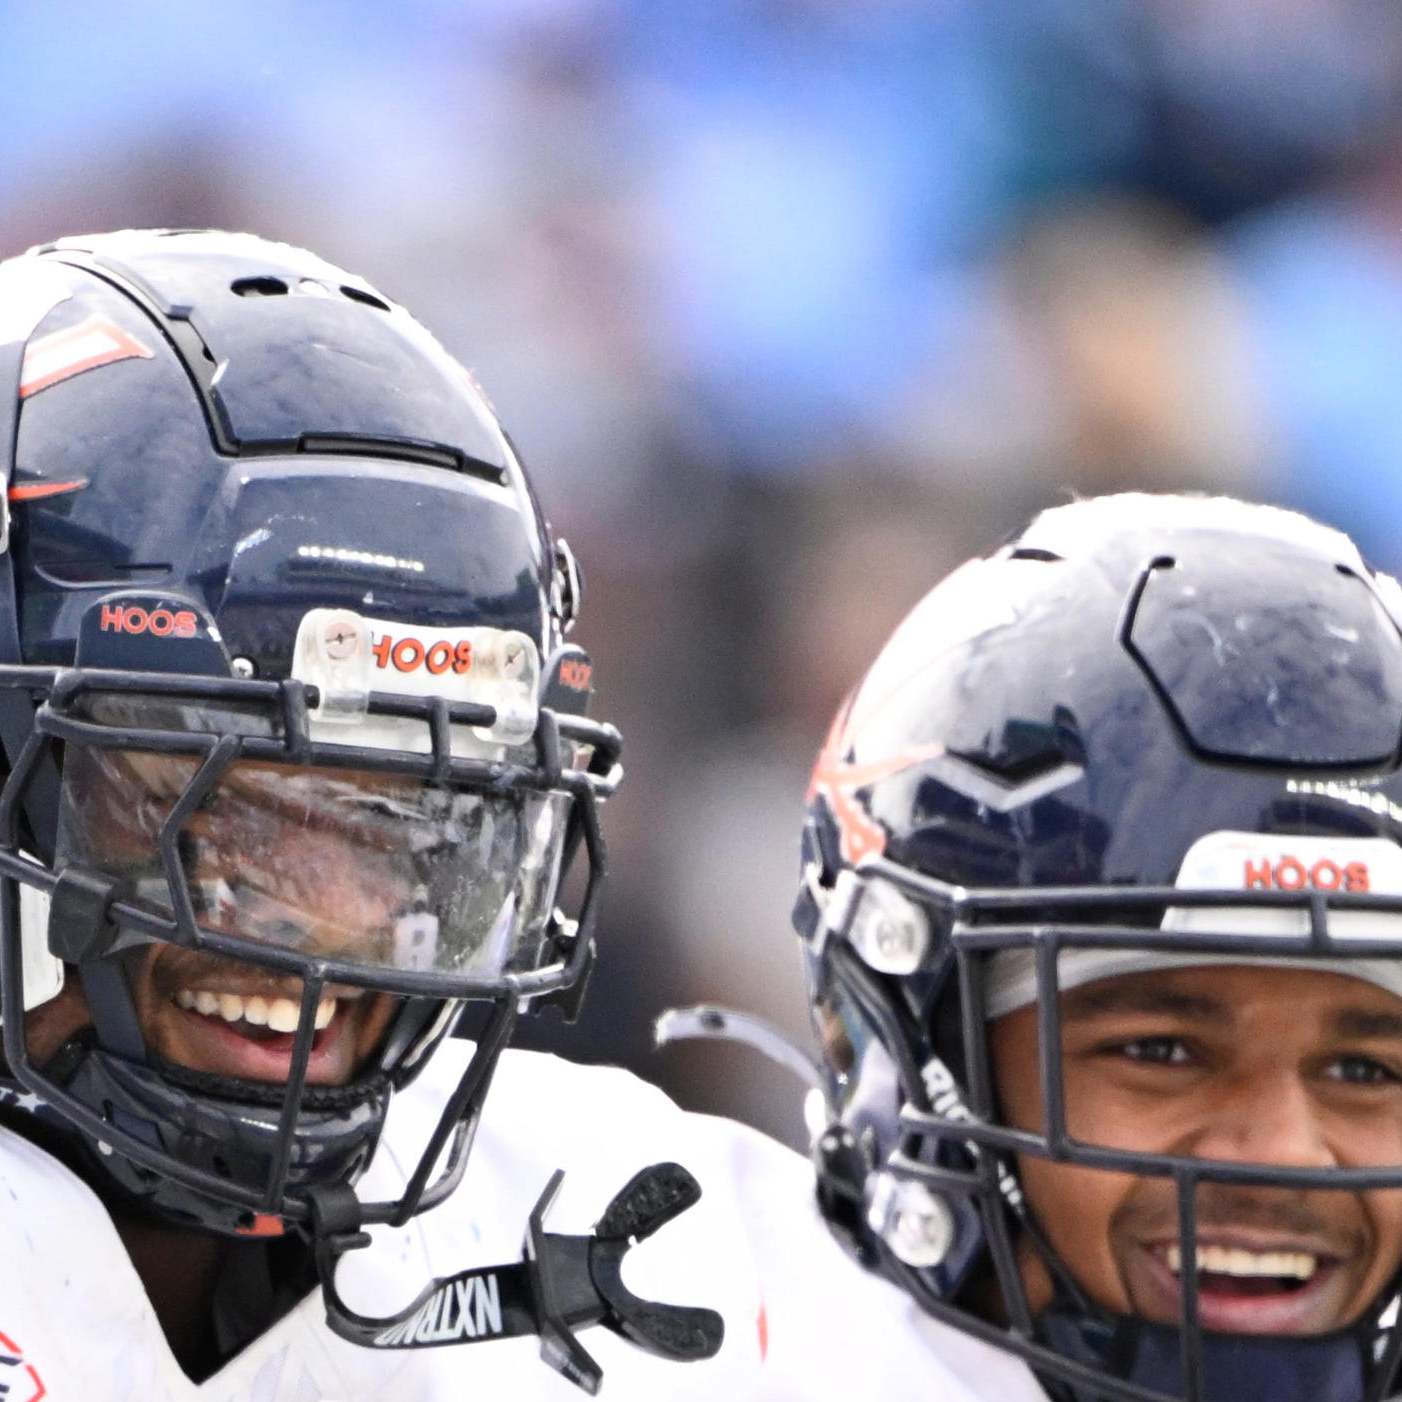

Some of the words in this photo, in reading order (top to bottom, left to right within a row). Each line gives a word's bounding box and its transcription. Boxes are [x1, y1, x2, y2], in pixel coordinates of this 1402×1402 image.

[101, 605, 197, 638] HOOS
[371, 633, 472, 676] HOOS
[1244, 857, 1370, 892] HOOS
